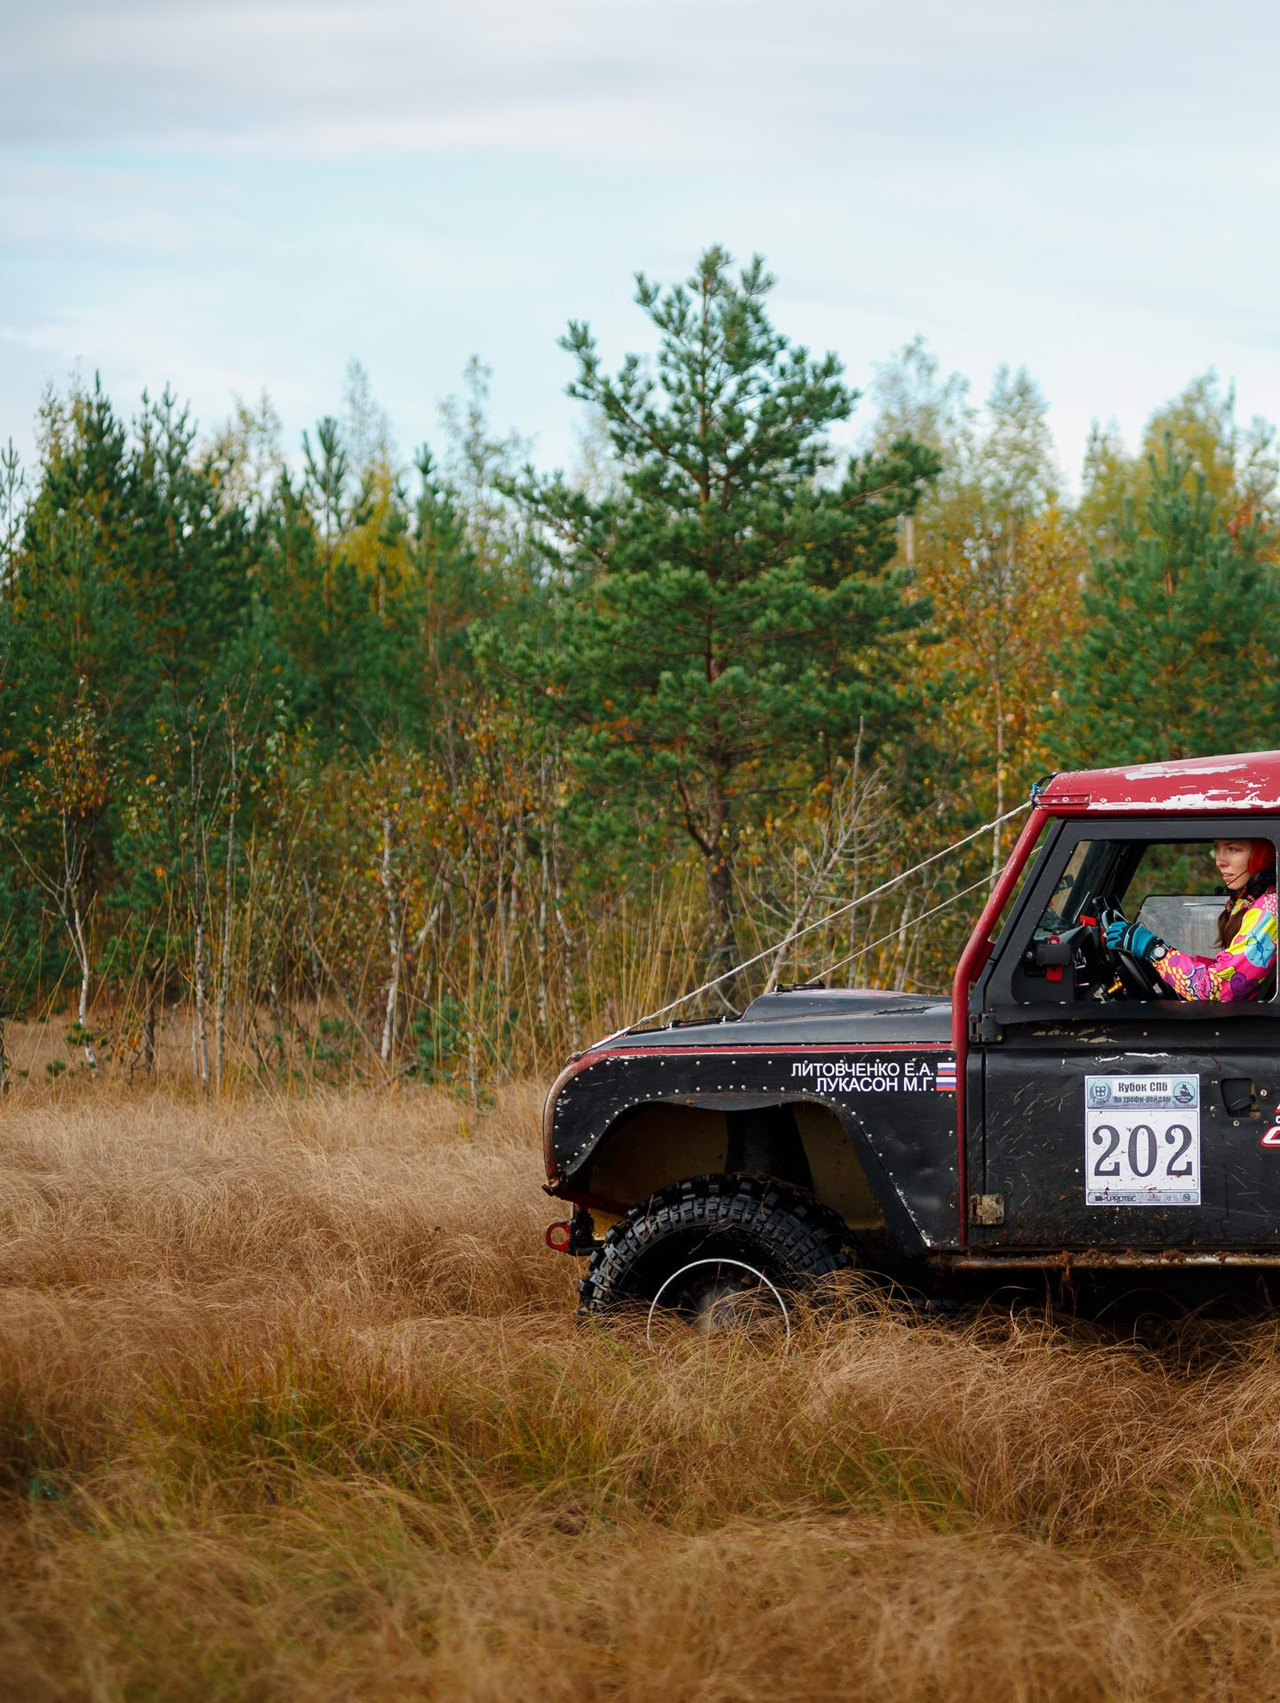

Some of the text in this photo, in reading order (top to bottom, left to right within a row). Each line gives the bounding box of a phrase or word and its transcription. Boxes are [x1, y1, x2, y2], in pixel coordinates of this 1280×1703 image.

[791, 1062, 935, 1077] ЛИТОВЧЕНКО Е.А.
[815, 1077, 935, 1092] ЛУКАСОН М.Г.
[1118, 1082, 1147, 1092] Кубок
[1092, 1124, 1193, 1178] 202
